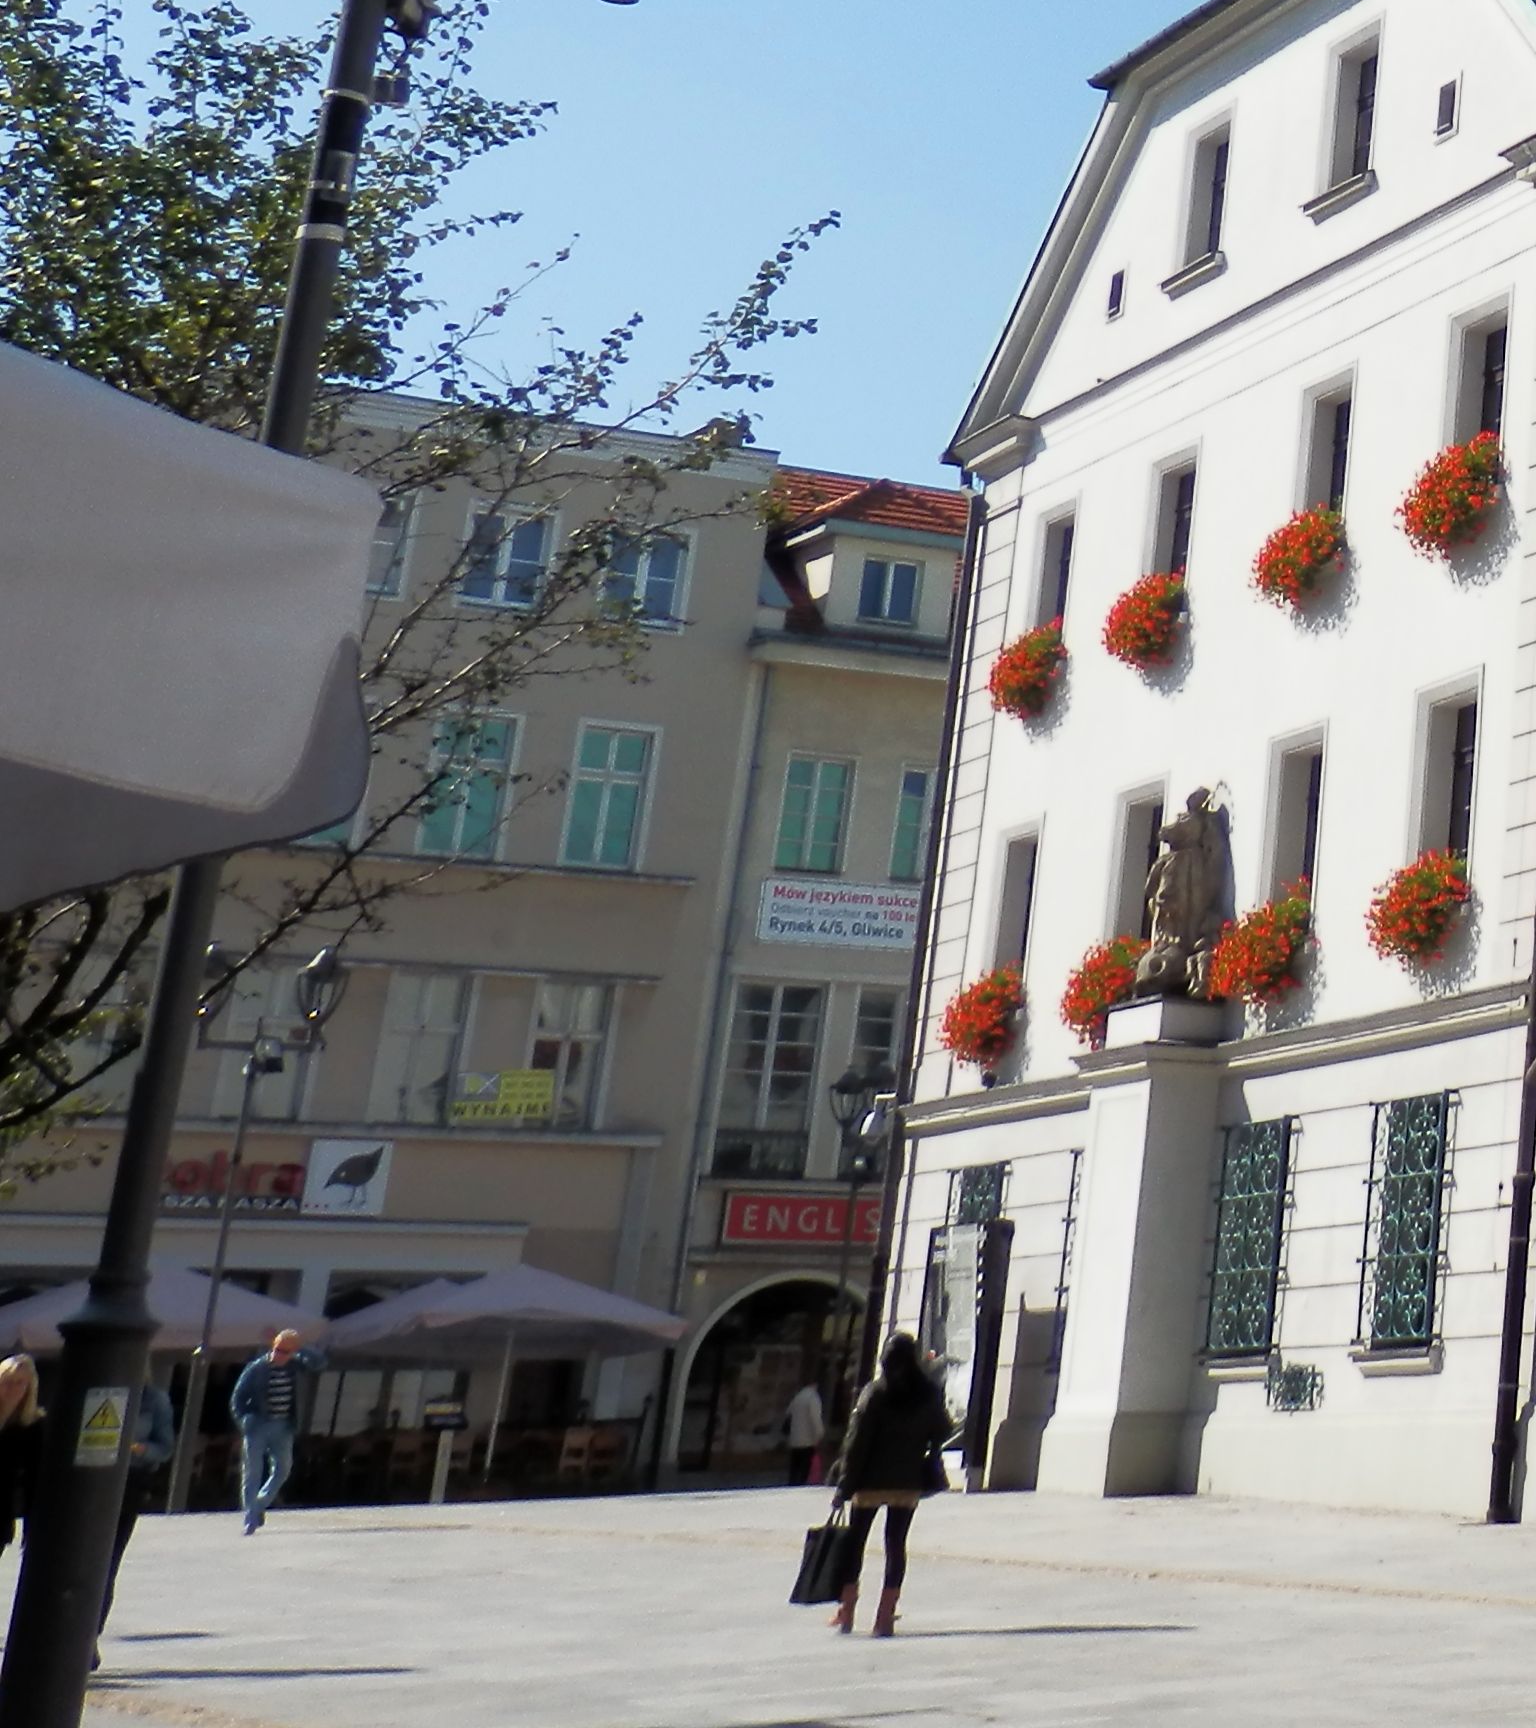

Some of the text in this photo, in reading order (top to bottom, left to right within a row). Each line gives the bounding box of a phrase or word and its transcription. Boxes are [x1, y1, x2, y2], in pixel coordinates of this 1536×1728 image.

[773, 885, 806, 900] Mów
[809, 888, 873, 905] językiem
[883, 910, 902, 921] 100
[769, 916, 815, 933] Rynek
[818, 920, 847, 936] 4/5,
[851, 921, 904, 939] Gliwice
[164, 1150, 304, 1194] obra
